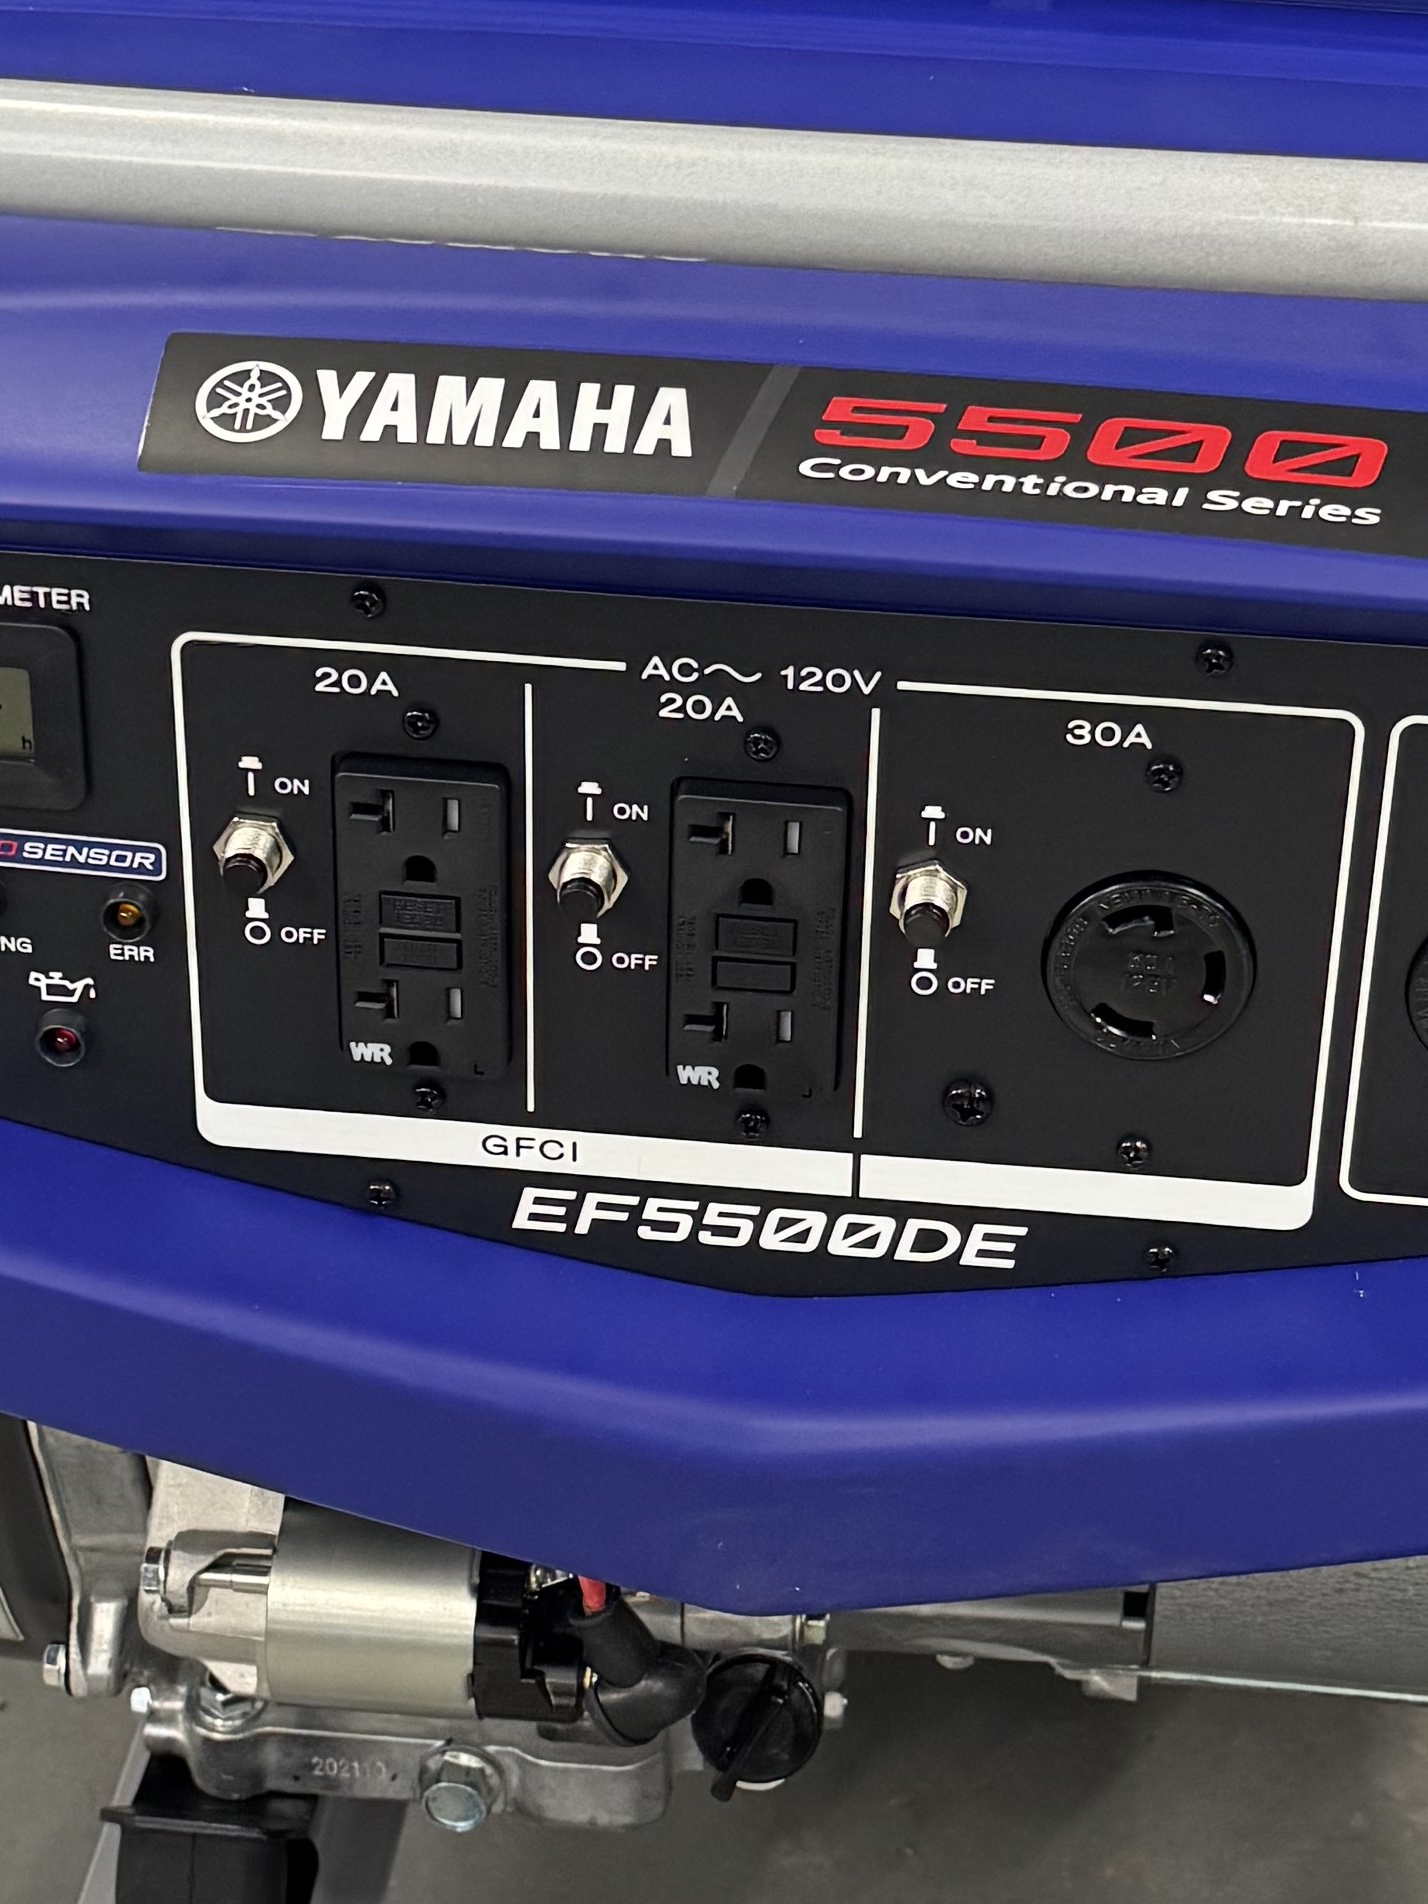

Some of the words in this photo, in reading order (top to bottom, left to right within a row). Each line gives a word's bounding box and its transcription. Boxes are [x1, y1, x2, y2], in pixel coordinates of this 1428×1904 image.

[316, 368, 693, 459] YAMAHA
[812, 396, 1390, 489] 5500
[799, 456, 1186, 510] Conventional
[1206, 489, 1384, 527] Series
[314, 666, 399, 697] 20A
[641, 655, 700, 683] AC
[779, 665, 882, 695] 120V
[658, 692, 744, 723] 20A
[1065, 719, 1153, 750] 30A
[274, 777, 310, 796] ON
[612, 802, 649, 821] ON
[955, 826, 992, 845] ON
[22, 841, 156, 871] SENSOR
[280, 926, 327, 945] OFF
[108, 943, 155, 963] ERR
[611, 952, 659, 971] OFF
[947, 976, 996, 995] OFF
[349, 1040, 393, 1067] WR
[676, 1064, 720, 1091] WR
[480, 1134, 580, 1164] GFCI
[511, 1184, 1030, 1271] EF5500DE
